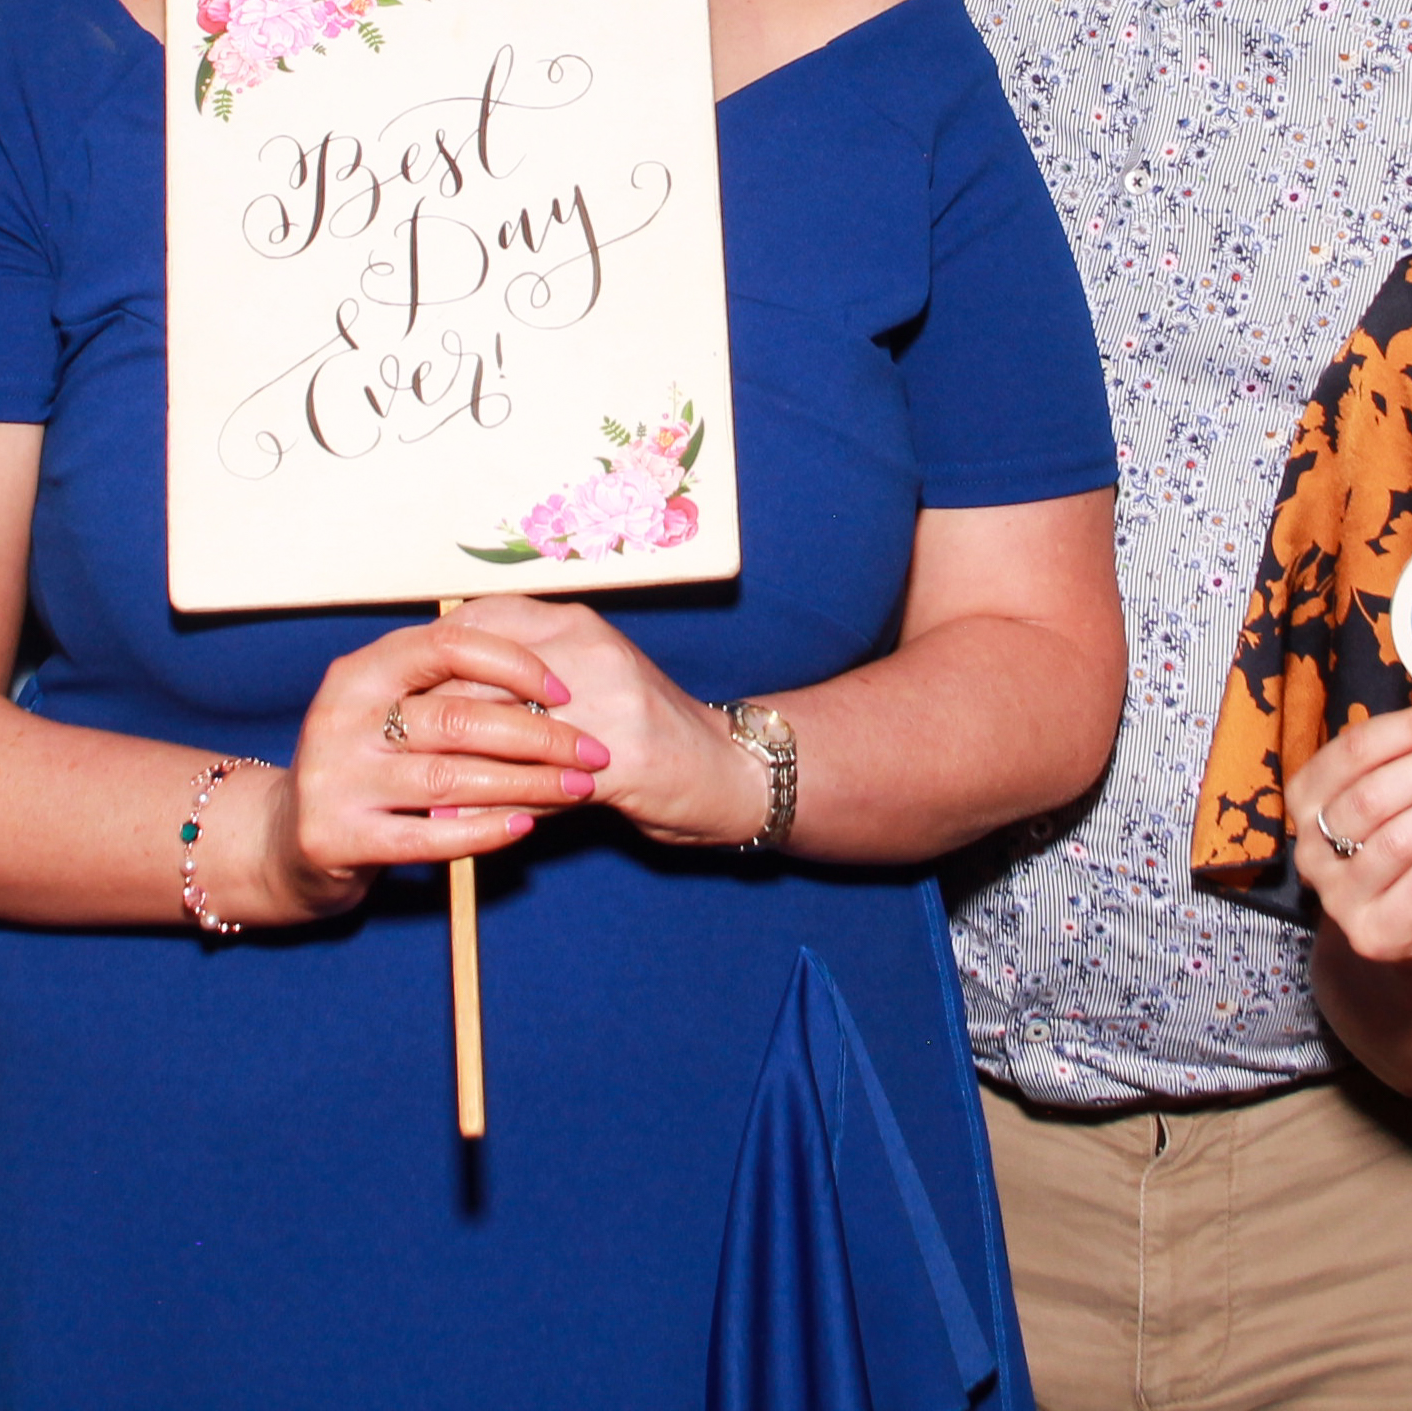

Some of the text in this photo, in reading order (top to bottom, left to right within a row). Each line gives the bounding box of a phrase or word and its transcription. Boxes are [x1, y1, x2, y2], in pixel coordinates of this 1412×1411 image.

[243, 44, 593, 259] Best
[360, 161, 671, 338] Day
[218, 299, 511, 480] Ever!
